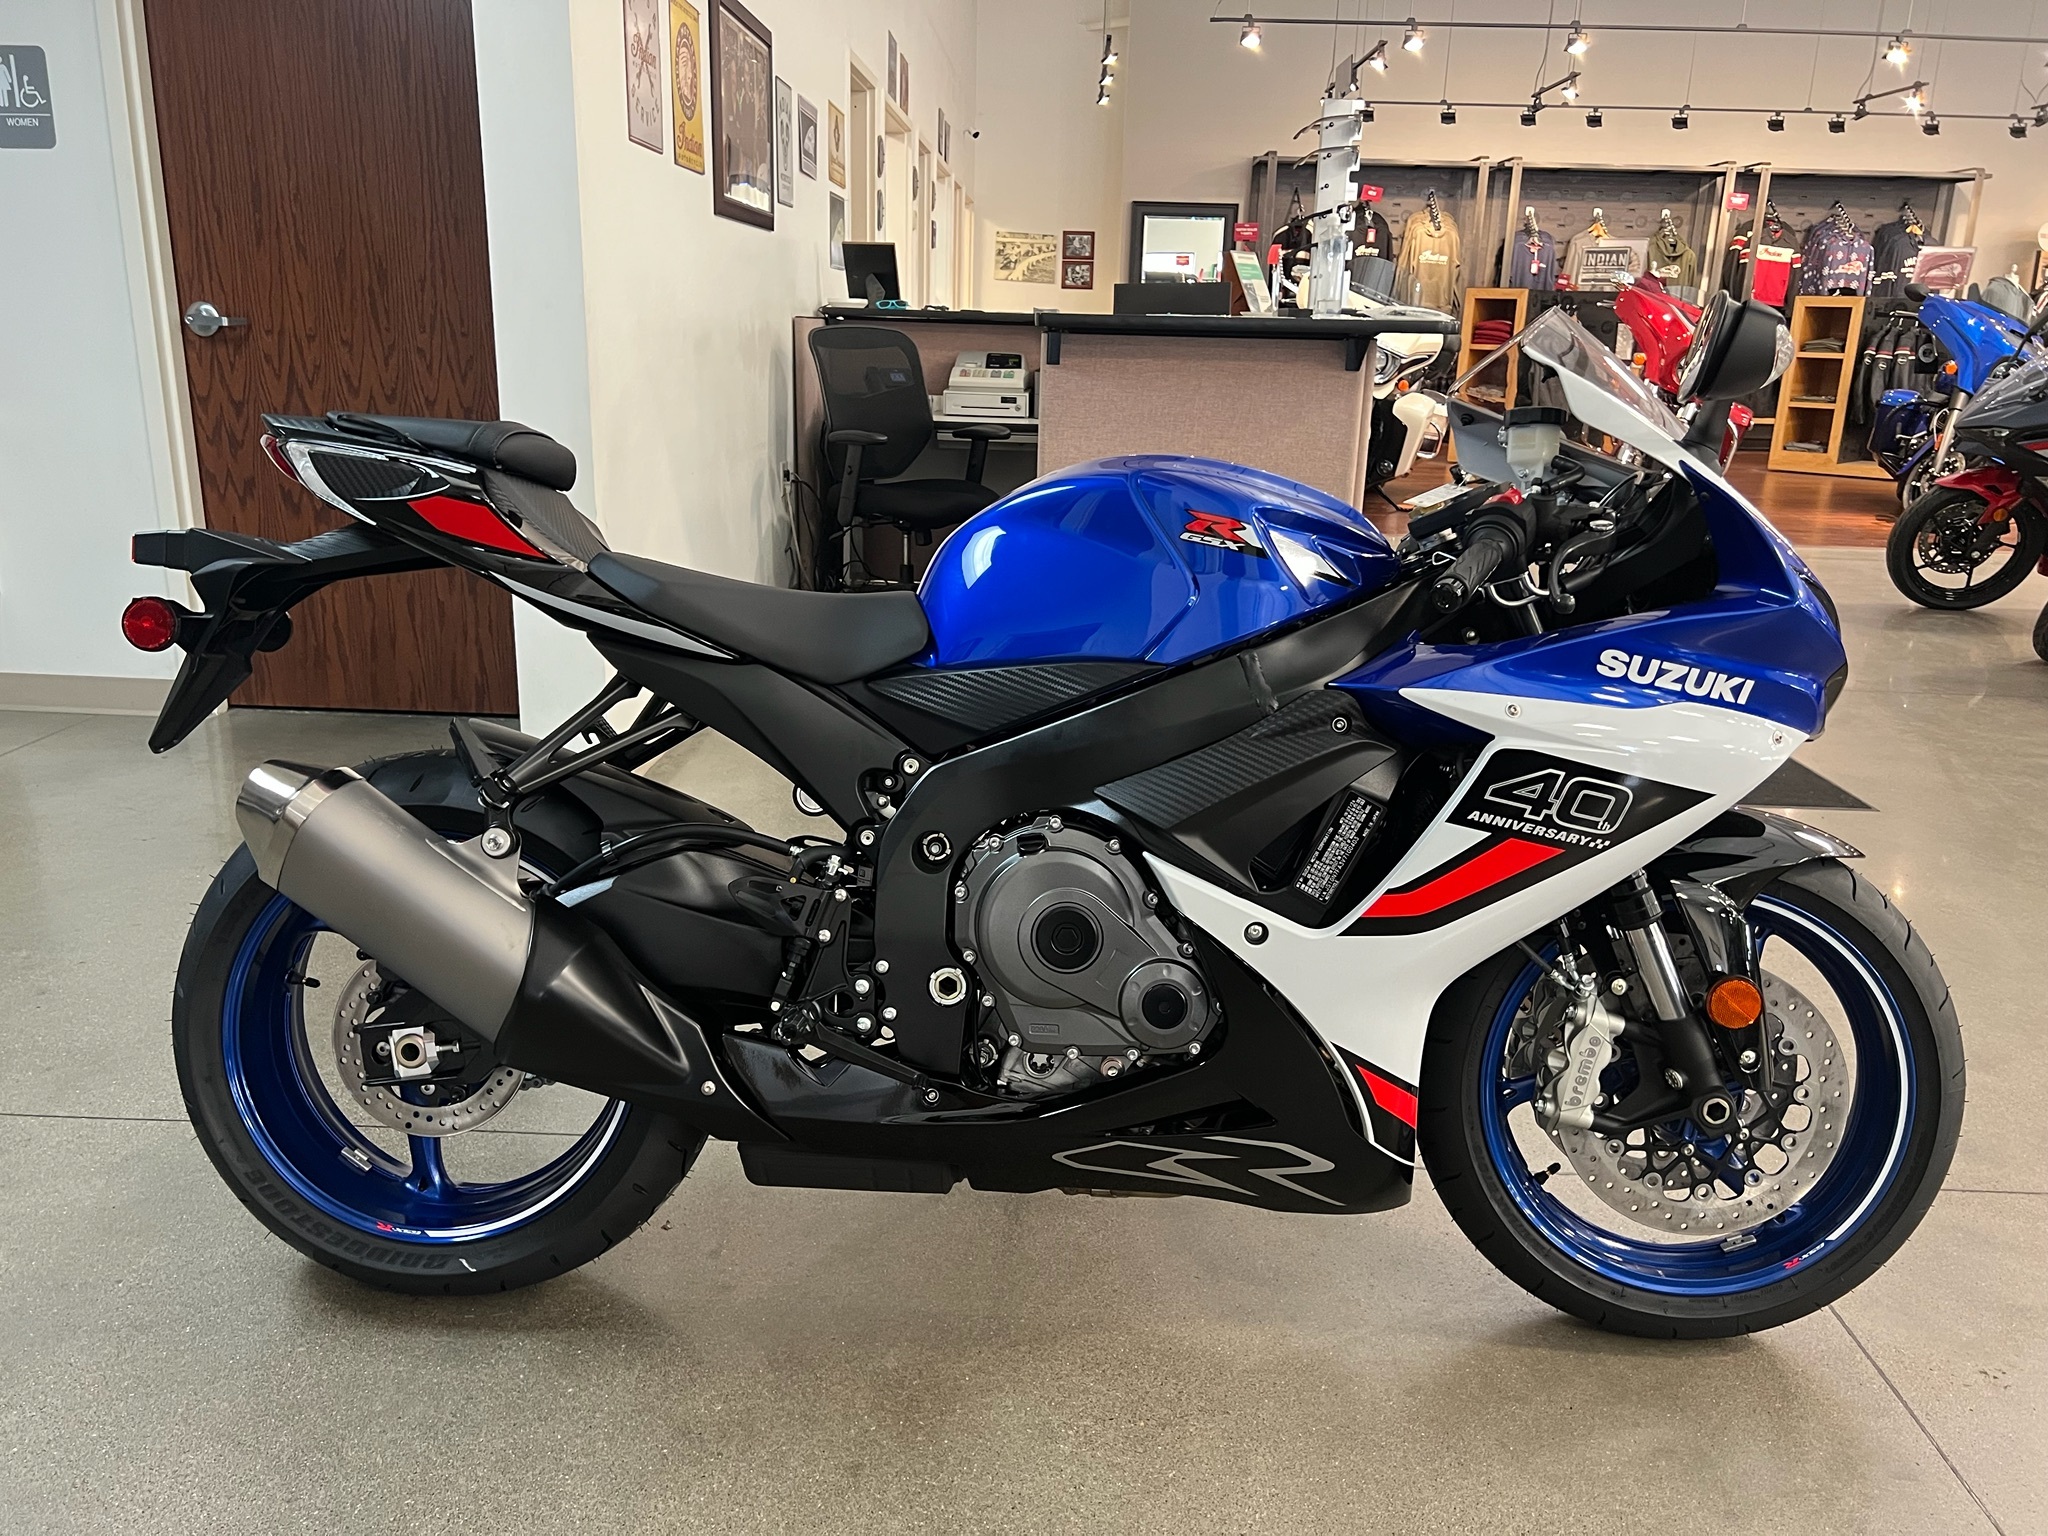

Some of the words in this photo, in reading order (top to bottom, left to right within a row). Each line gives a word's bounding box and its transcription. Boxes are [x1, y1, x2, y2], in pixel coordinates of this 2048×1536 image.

[6, 117, 39, 127] WOMEN
[676, 121, 702, 158] Indian
[1584, 252, 1628, 267] INDIAN
[1180, 531, 1247, 551] GSX
[1596, 648, 1755, 706] SUZUKI
[1483, 768, 1634, 835] 40
[1597, 820, 1612, 831] th
[1467, 809, 1592, 847] ANNIVERSARY
[1564, 1036, 1602, 1107] brembo
[243, 1169, 451, 1270] BRIDGESTONE
